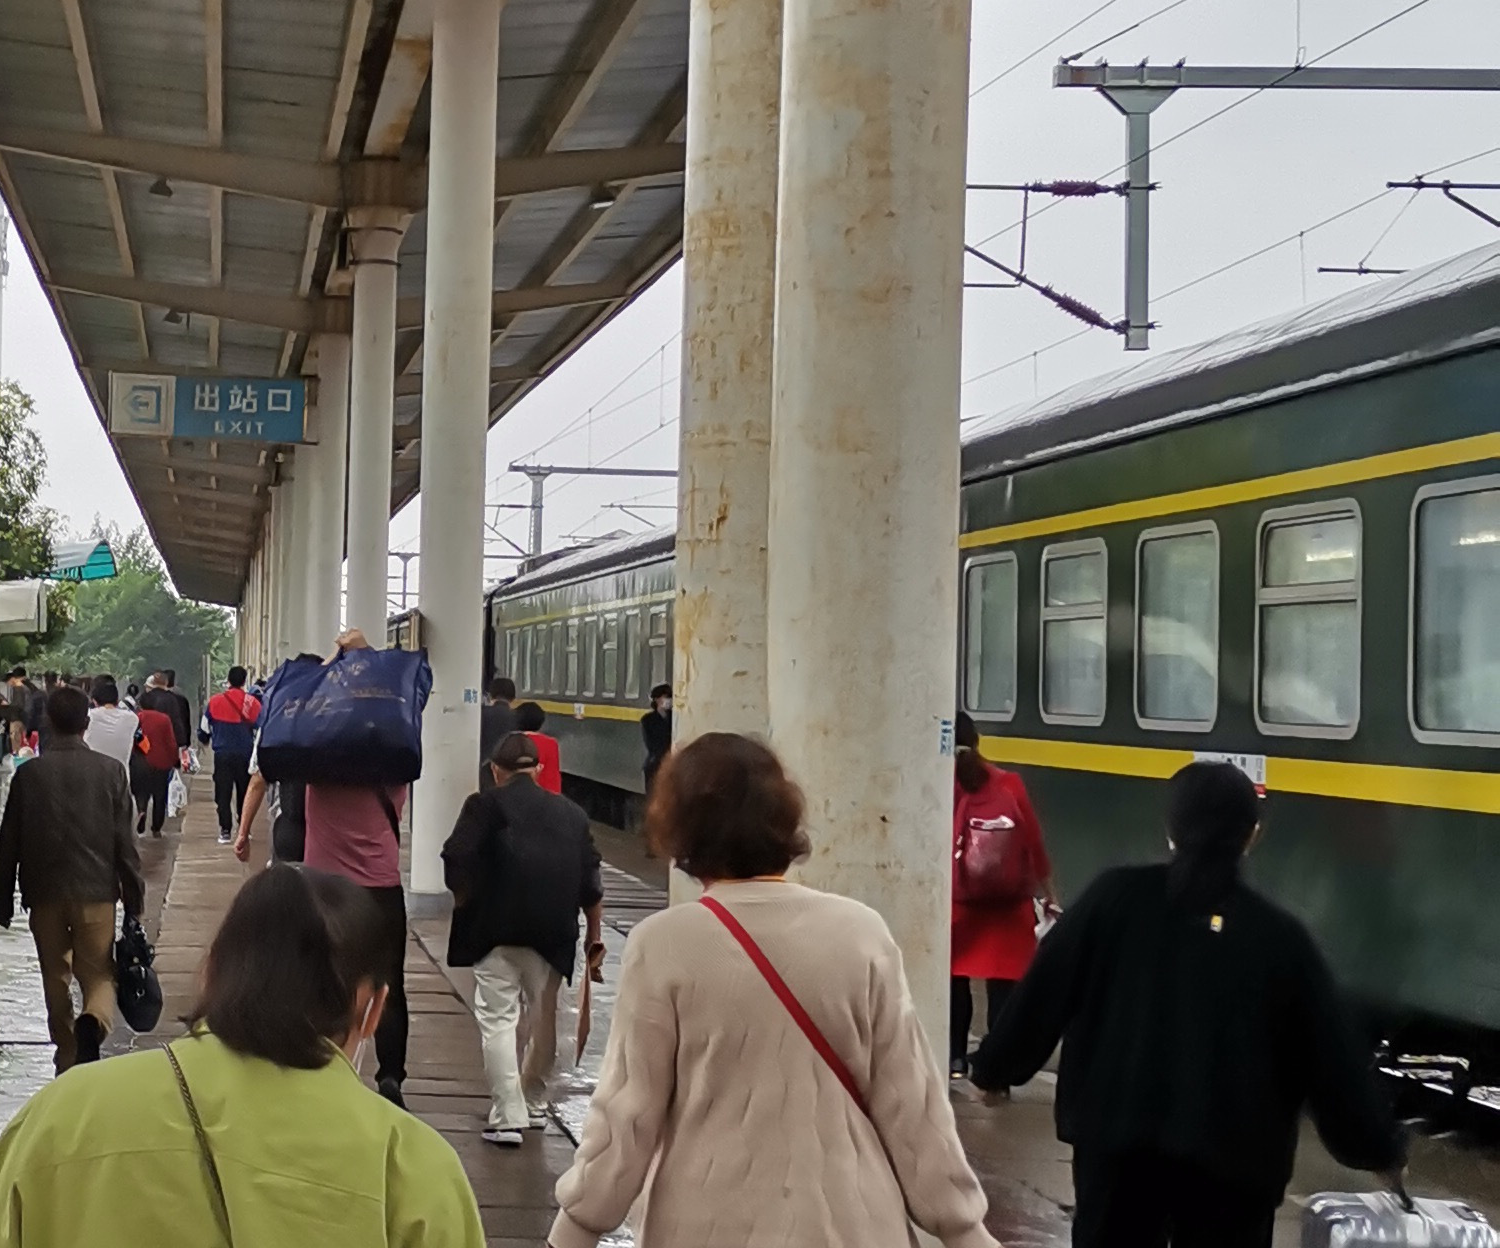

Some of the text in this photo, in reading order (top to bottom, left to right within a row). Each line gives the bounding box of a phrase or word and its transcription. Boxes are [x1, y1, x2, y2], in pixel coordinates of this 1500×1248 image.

[194, 382, 292, 414] 出站口
[214, 420, 264, 436] EXIT
